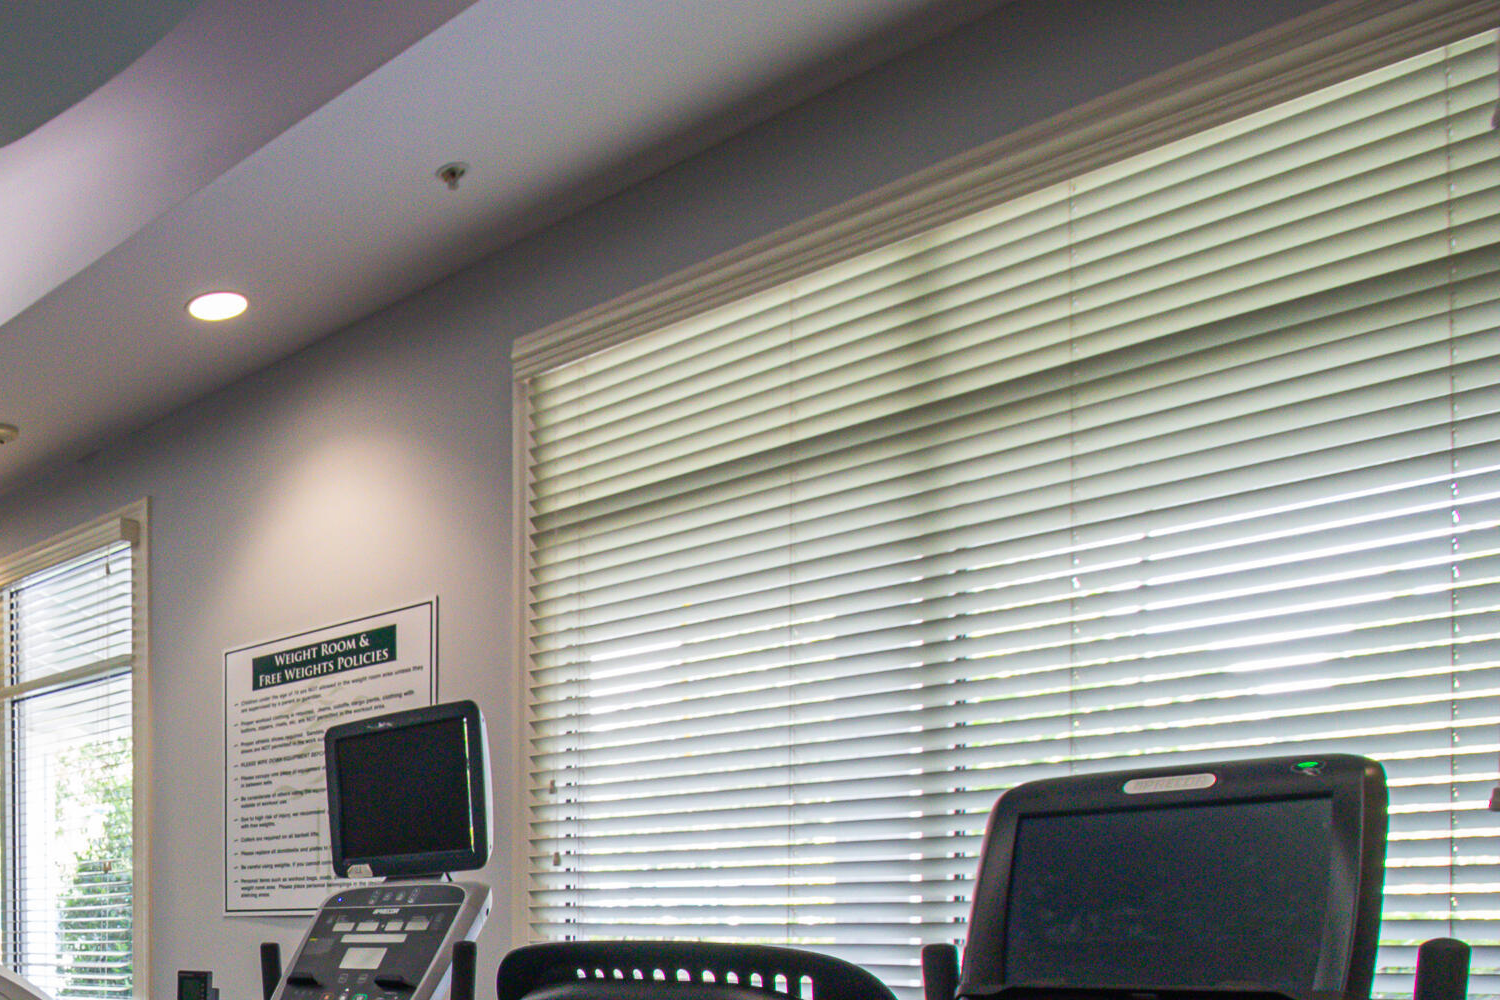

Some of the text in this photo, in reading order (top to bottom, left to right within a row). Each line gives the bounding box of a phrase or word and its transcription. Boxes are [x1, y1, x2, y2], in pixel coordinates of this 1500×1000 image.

[259, 648, 389, 687] FREE WEIGHTS POLICIES
[274, 633, 370, 667] WEIGHT ROOM &
